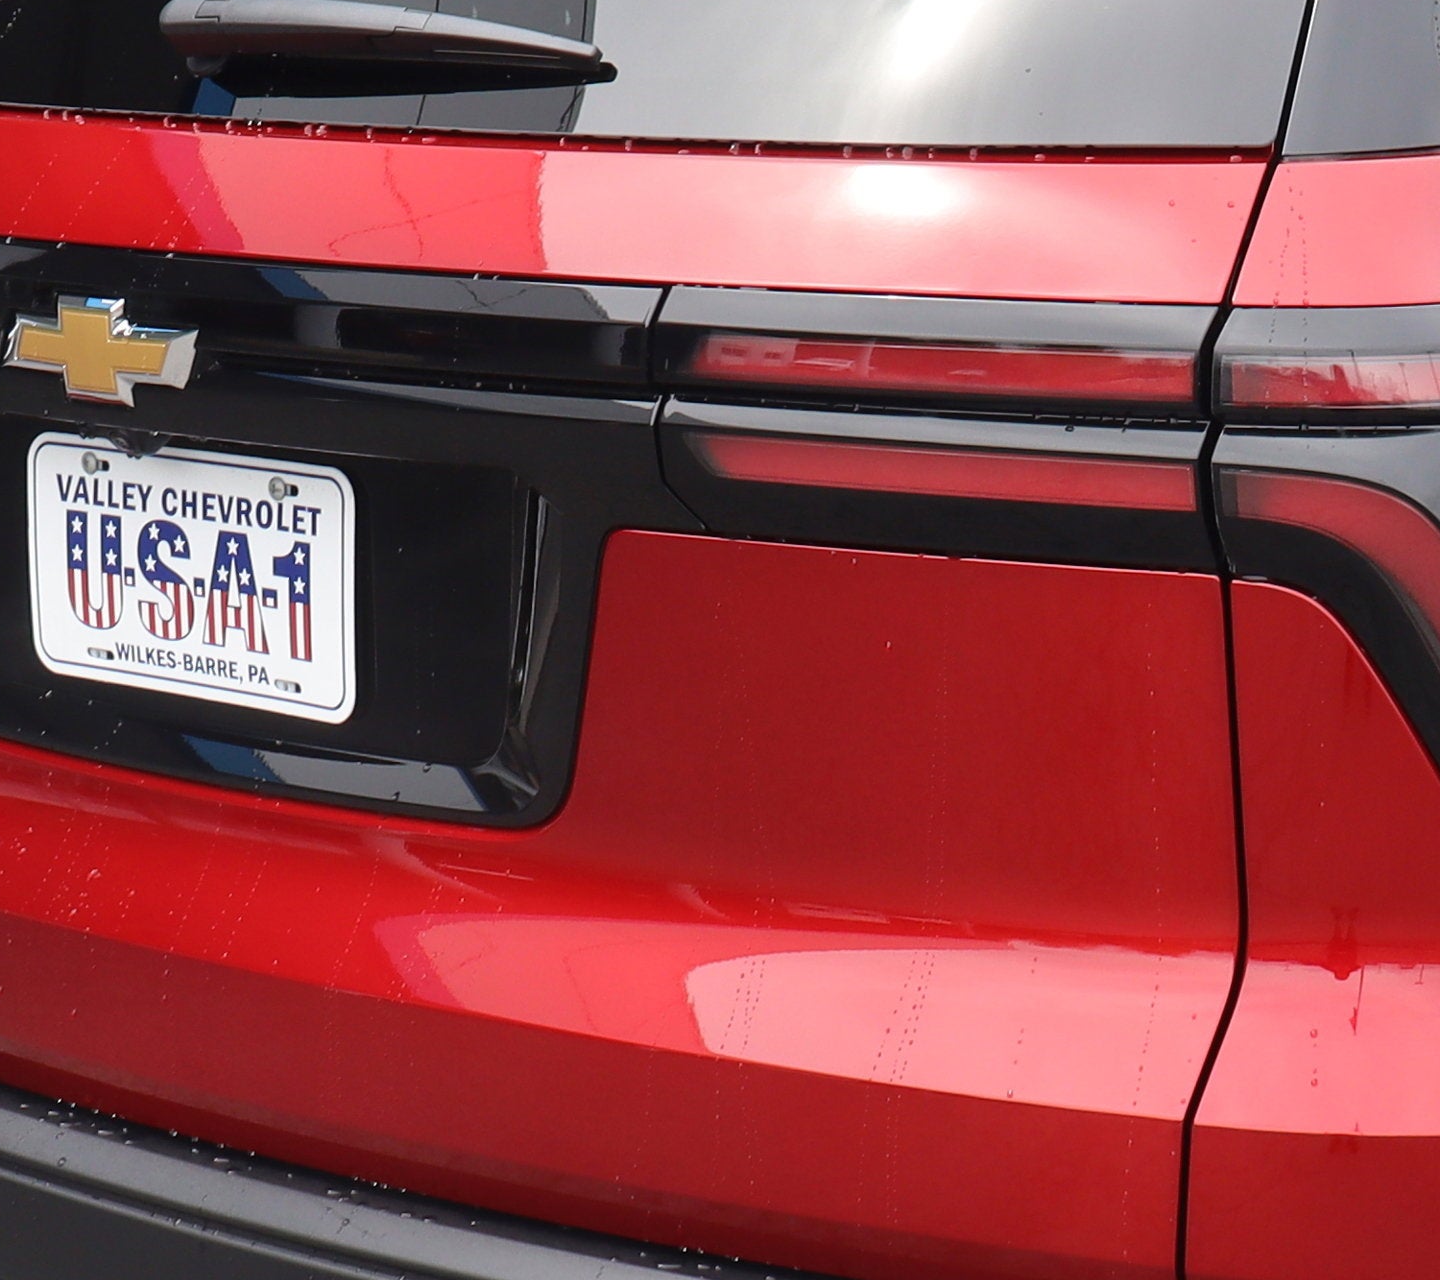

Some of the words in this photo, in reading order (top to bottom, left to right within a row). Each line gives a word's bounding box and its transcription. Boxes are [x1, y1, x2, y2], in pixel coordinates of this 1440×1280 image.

[56, 473, 153, 513] VALLEY
[161, 487, 321, 537] CHEVROLET
[115, 641, 244, 686] WILKES-BARRE,
[248, 664, 271, 687] PA
